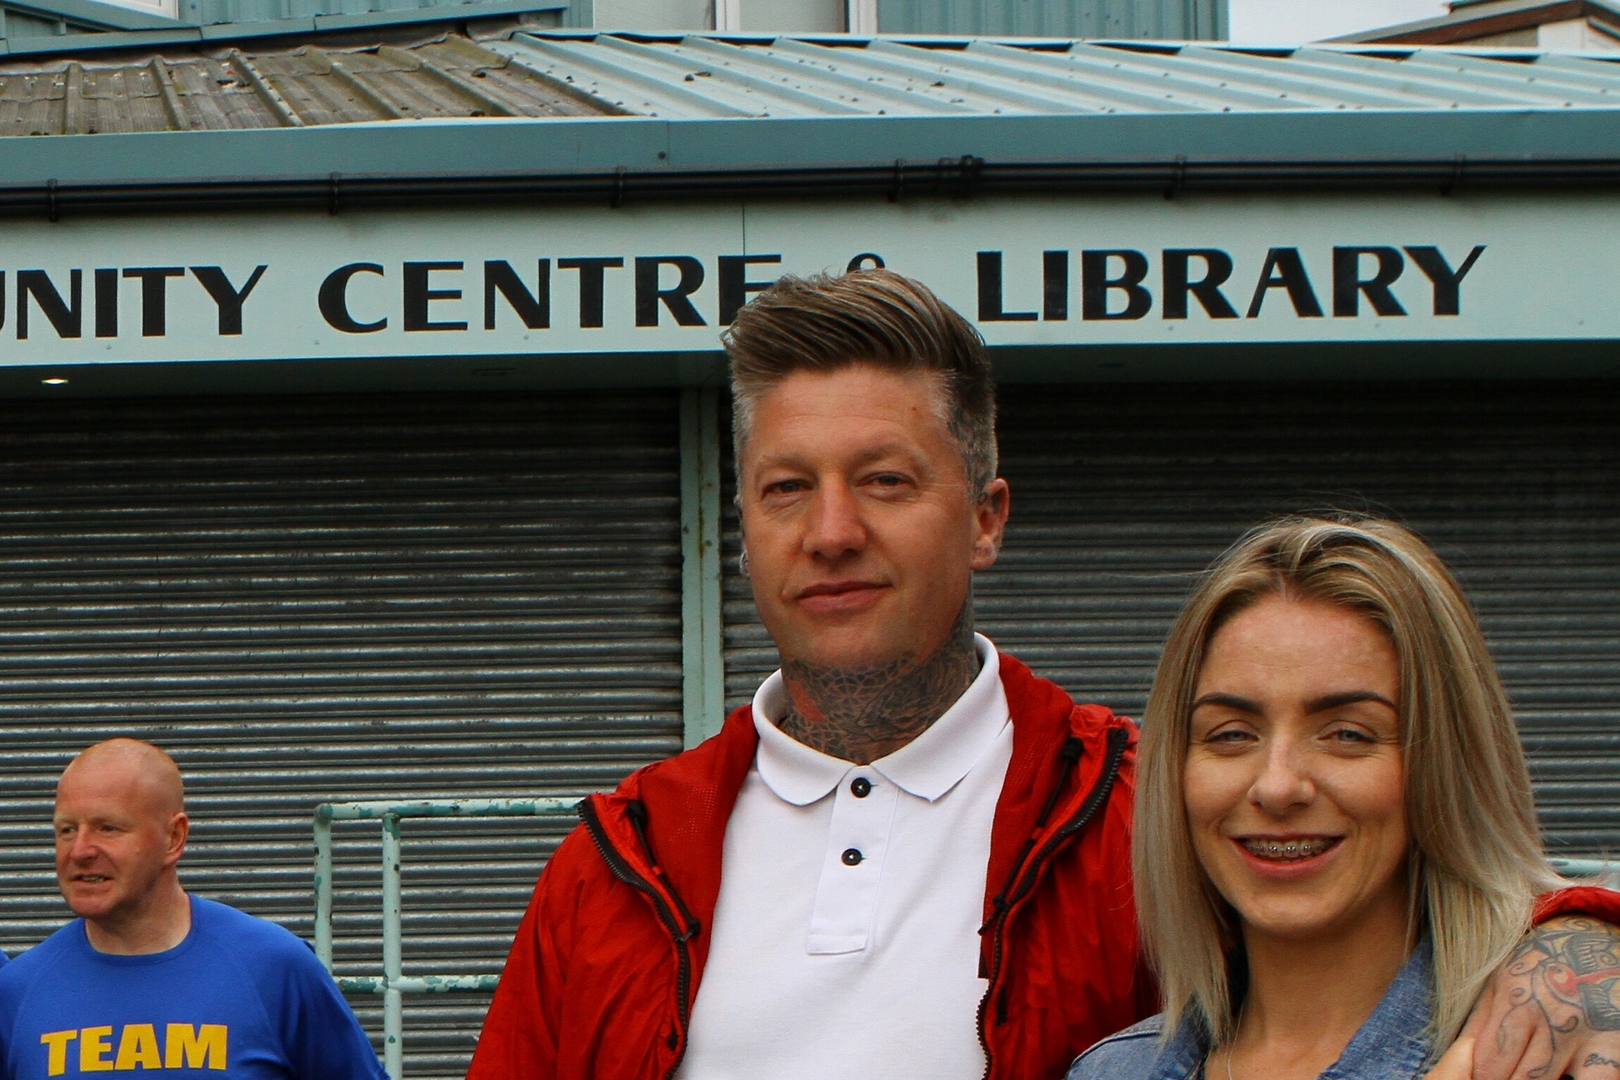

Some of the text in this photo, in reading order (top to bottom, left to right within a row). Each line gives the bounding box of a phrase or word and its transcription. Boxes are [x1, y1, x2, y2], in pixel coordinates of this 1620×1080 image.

[318, 254, 782, 333] CENTRE
[975, 245, 1487, 322] LIBRARY
[40, 1023, 229, 1077] TEAM
